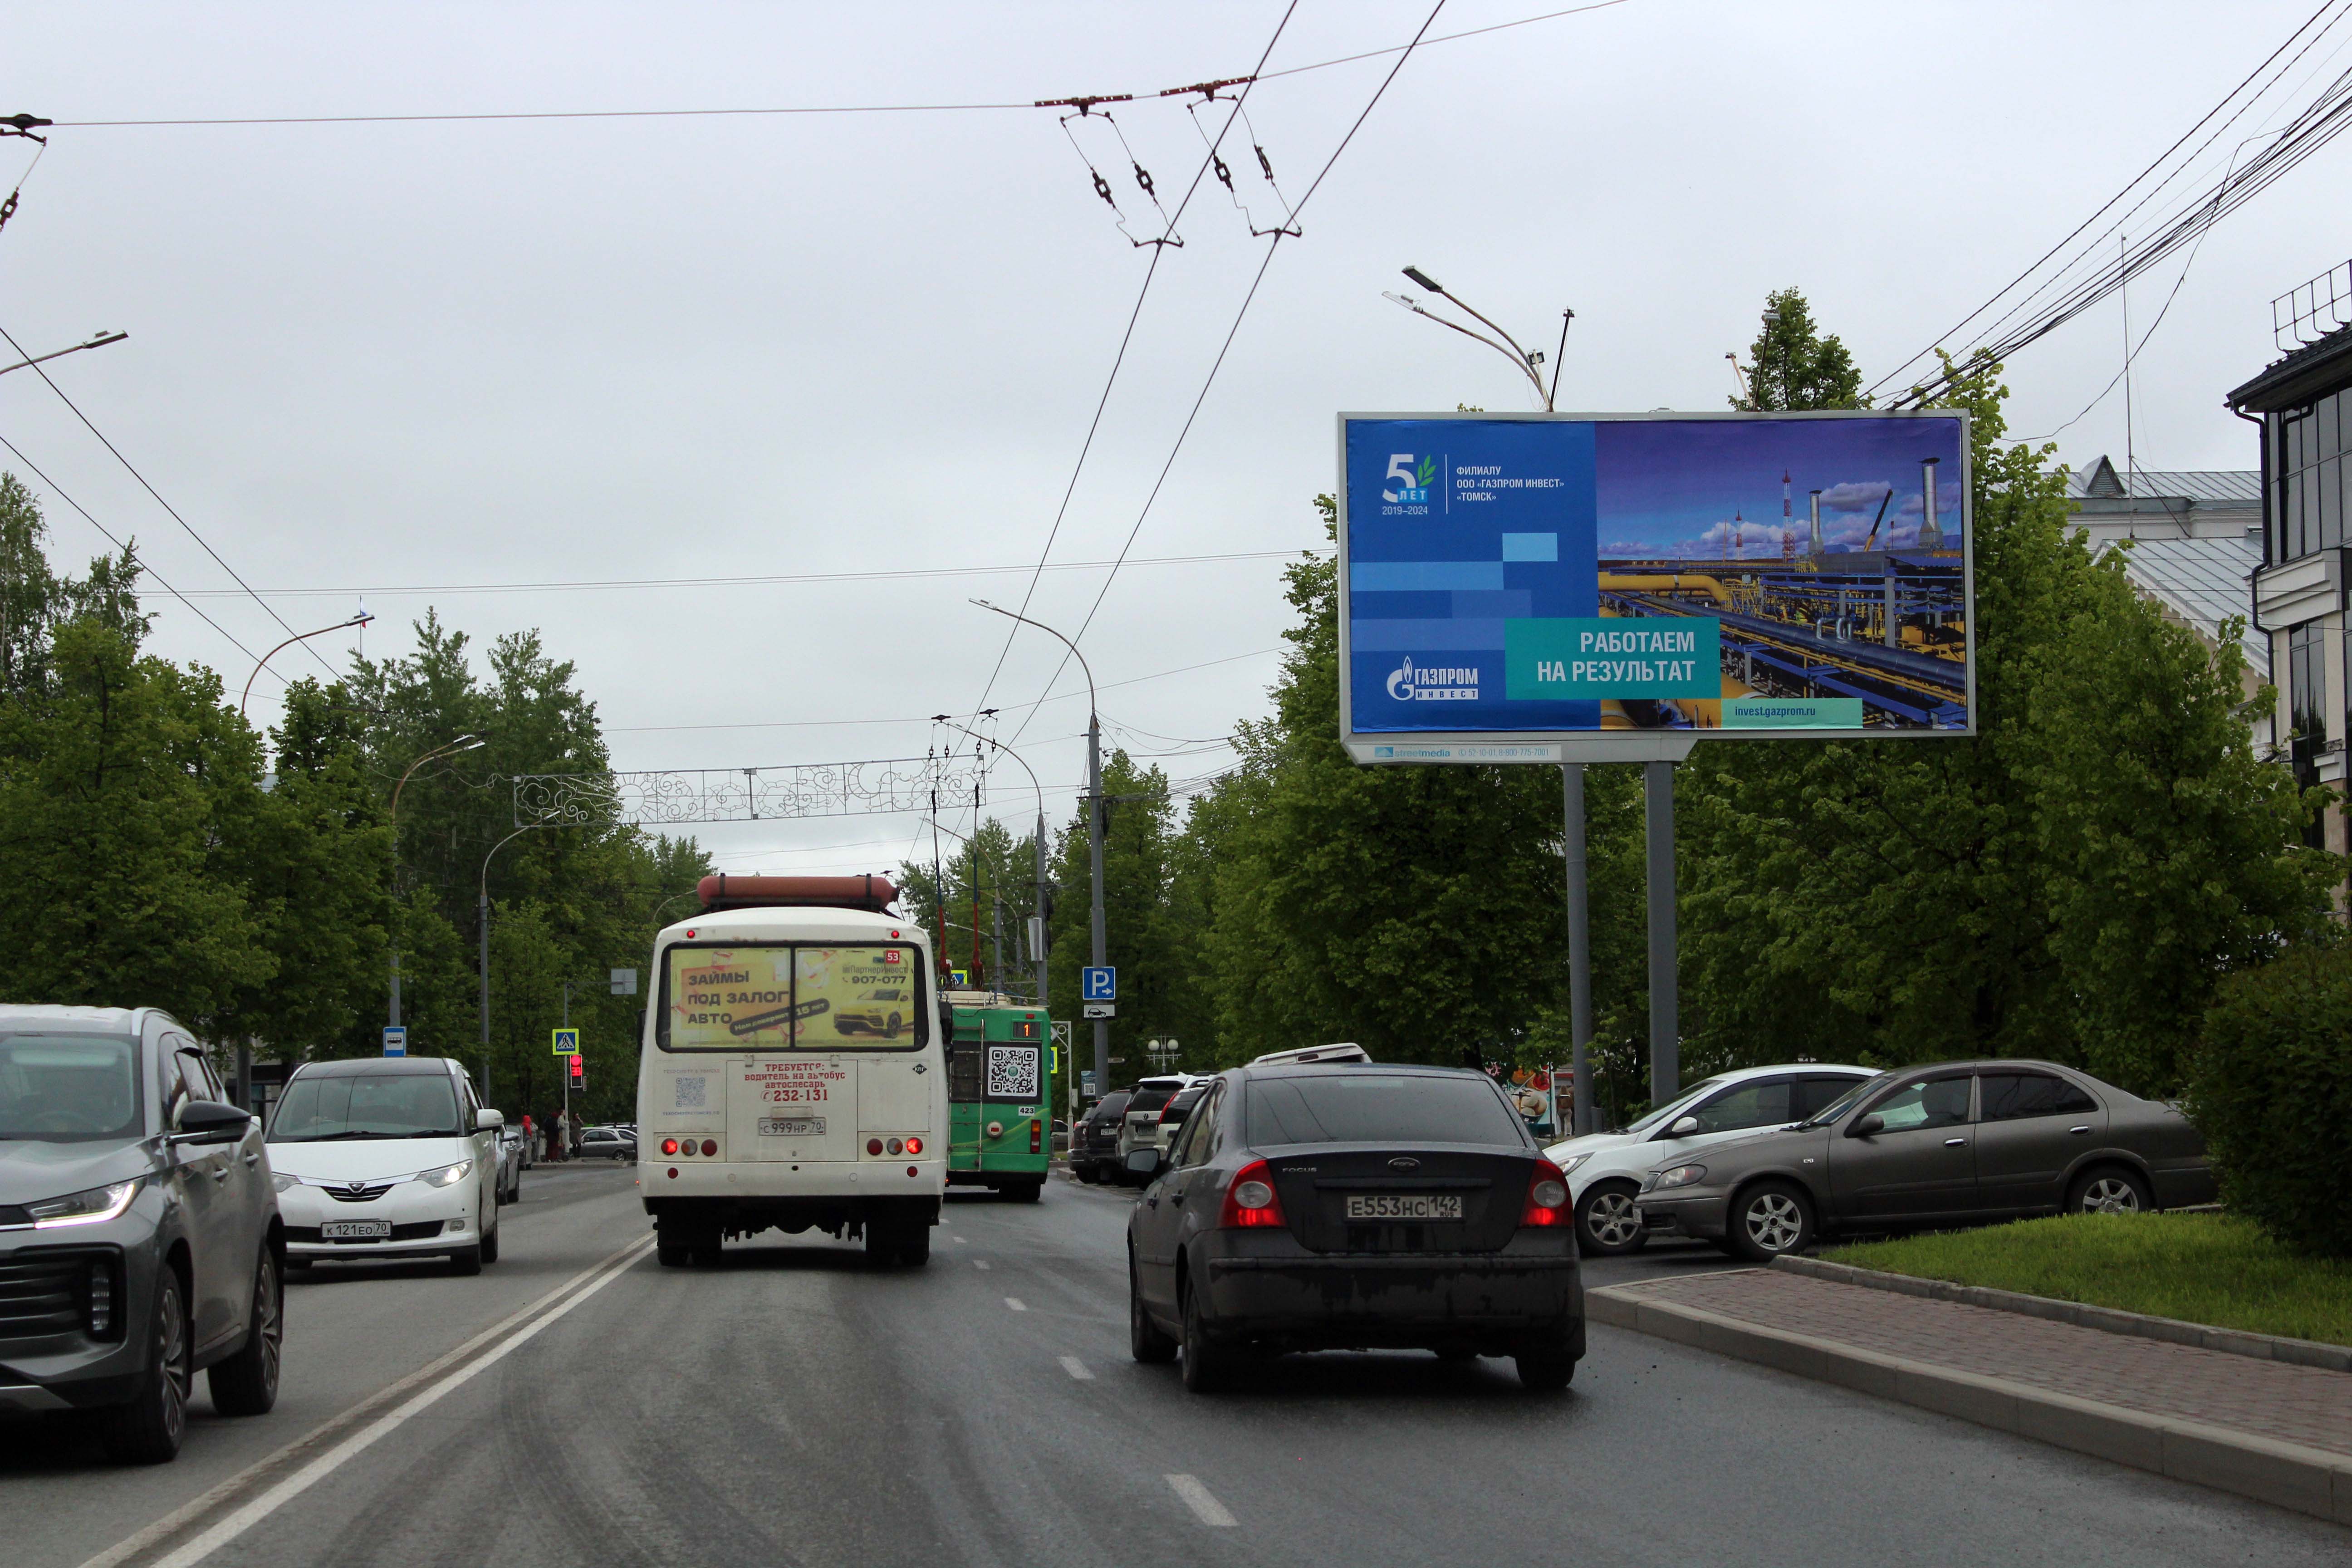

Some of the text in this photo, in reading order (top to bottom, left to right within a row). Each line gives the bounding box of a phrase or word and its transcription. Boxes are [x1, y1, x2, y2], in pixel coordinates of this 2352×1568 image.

[1456, 466, 1501, 475] ФИЛИАЛУ
[1382, 454, 1416, 503] 5
[1456, 479, 1564, 489] ООО «ГАЗПРОМ ИНВЕСТ»
[1400, 490, 1426, 501] ЛЕТ
[1456, 492, 1497, 501] «ТОМСК»
[1580, 631, 1695, 654] РАБОТАЕМ
[1415, 668, 1479, 685] ГАЗПРОМ
[1538, 661, 1695, 682] НА РЕЗУЛЬТАТ
[1417, 690, 1477, 699] ИНВЕСТ
[1735, 706, 1816, 718] invest.gazprom.ru
[1394, 749, 1451, 758] streetmedia
[887, 953, 899, 961] 53
[688, 970, 750, 986] ЗАЙМЫ
[852, 976, 906, 984] 907-077
[1092, 971, 1109, 995] P
[688, 991, 789, 1006] ПОД ЗАЛОГ
[688, 1013, 732, 1024] АВТО
[1024, 1024, 1030, 1037] 1
[745, 1073, 789, 1081] водитель
[765, 1081, 825, 1089] автослесарь
[774, 1089, 828, 1102] 232-131
[375, 1223, 387, 1231] 70
